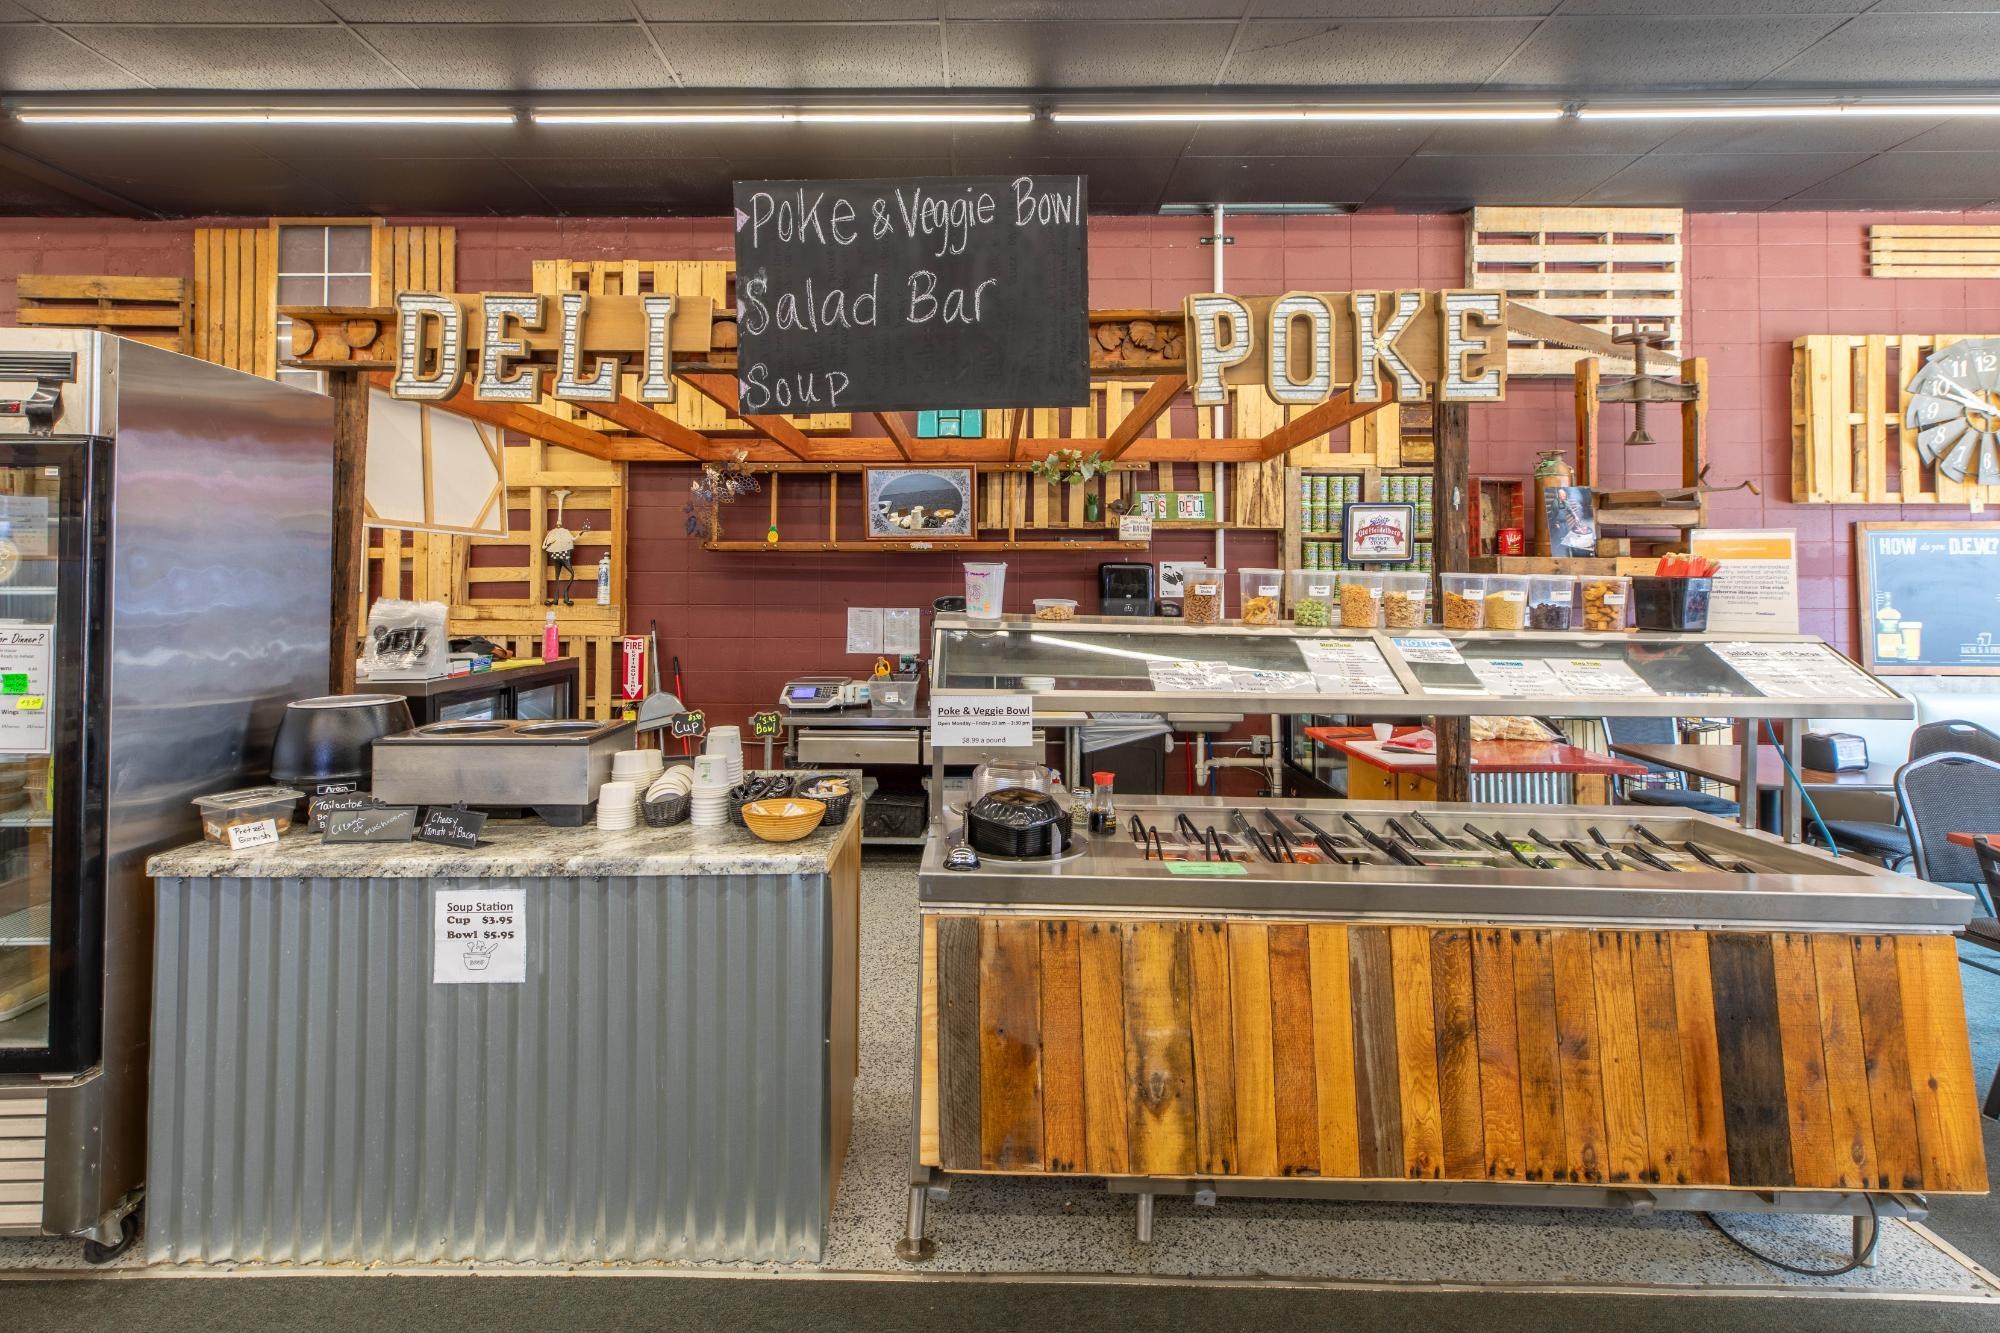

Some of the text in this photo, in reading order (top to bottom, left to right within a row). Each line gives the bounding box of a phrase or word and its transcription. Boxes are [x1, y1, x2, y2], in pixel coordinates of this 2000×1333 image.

[872, 198, 893, 240] &
[895, 187, 995, 257] Veggie
[1011, 176, 1081, 227] Bowl
[746, 270, 997, 335] Salad Bar
[390, 290, 678, 403] DELI
[1189, 288, 1507, 405] POKE
[1951, 360, 1967, 378] 11
[1975, 355, 1997, 372] 12
[746, 362, 849, 409] Soup
[1932, 377, 1950, 396] 10
[1927, 402, 1939, 419] 9
[1934, 427, 1946, 444] 8
[1953, 446, 1967, 464] 7
[1983, 452, 1991, 469] 6
[1179, 500, 1203, 513] DELI
[1880, 538, 1917, 555] HOW
[11, 633, 45, 644] Dinner?
[625, 641, 642, 650] FIRE
[938, 706, 1030, 717] Poke & Veggie Bowl
[675, 720, 699, 734] Cup
[756, 722, 776, 735] Bowl
[331, 817, 367, 835] Cream
[432, 813, 459, 827] Cheesy
[233, 823, 265, 835] Pretzel
[238, 832, 271, 843] Garnish
[457, 826, 477, 840] Bacon
[447, 902, 513, 913] Soup Station
[447, 916, 513, 925] Cup $3.95
[447, 931, 515, 939] Bowl $5.95
